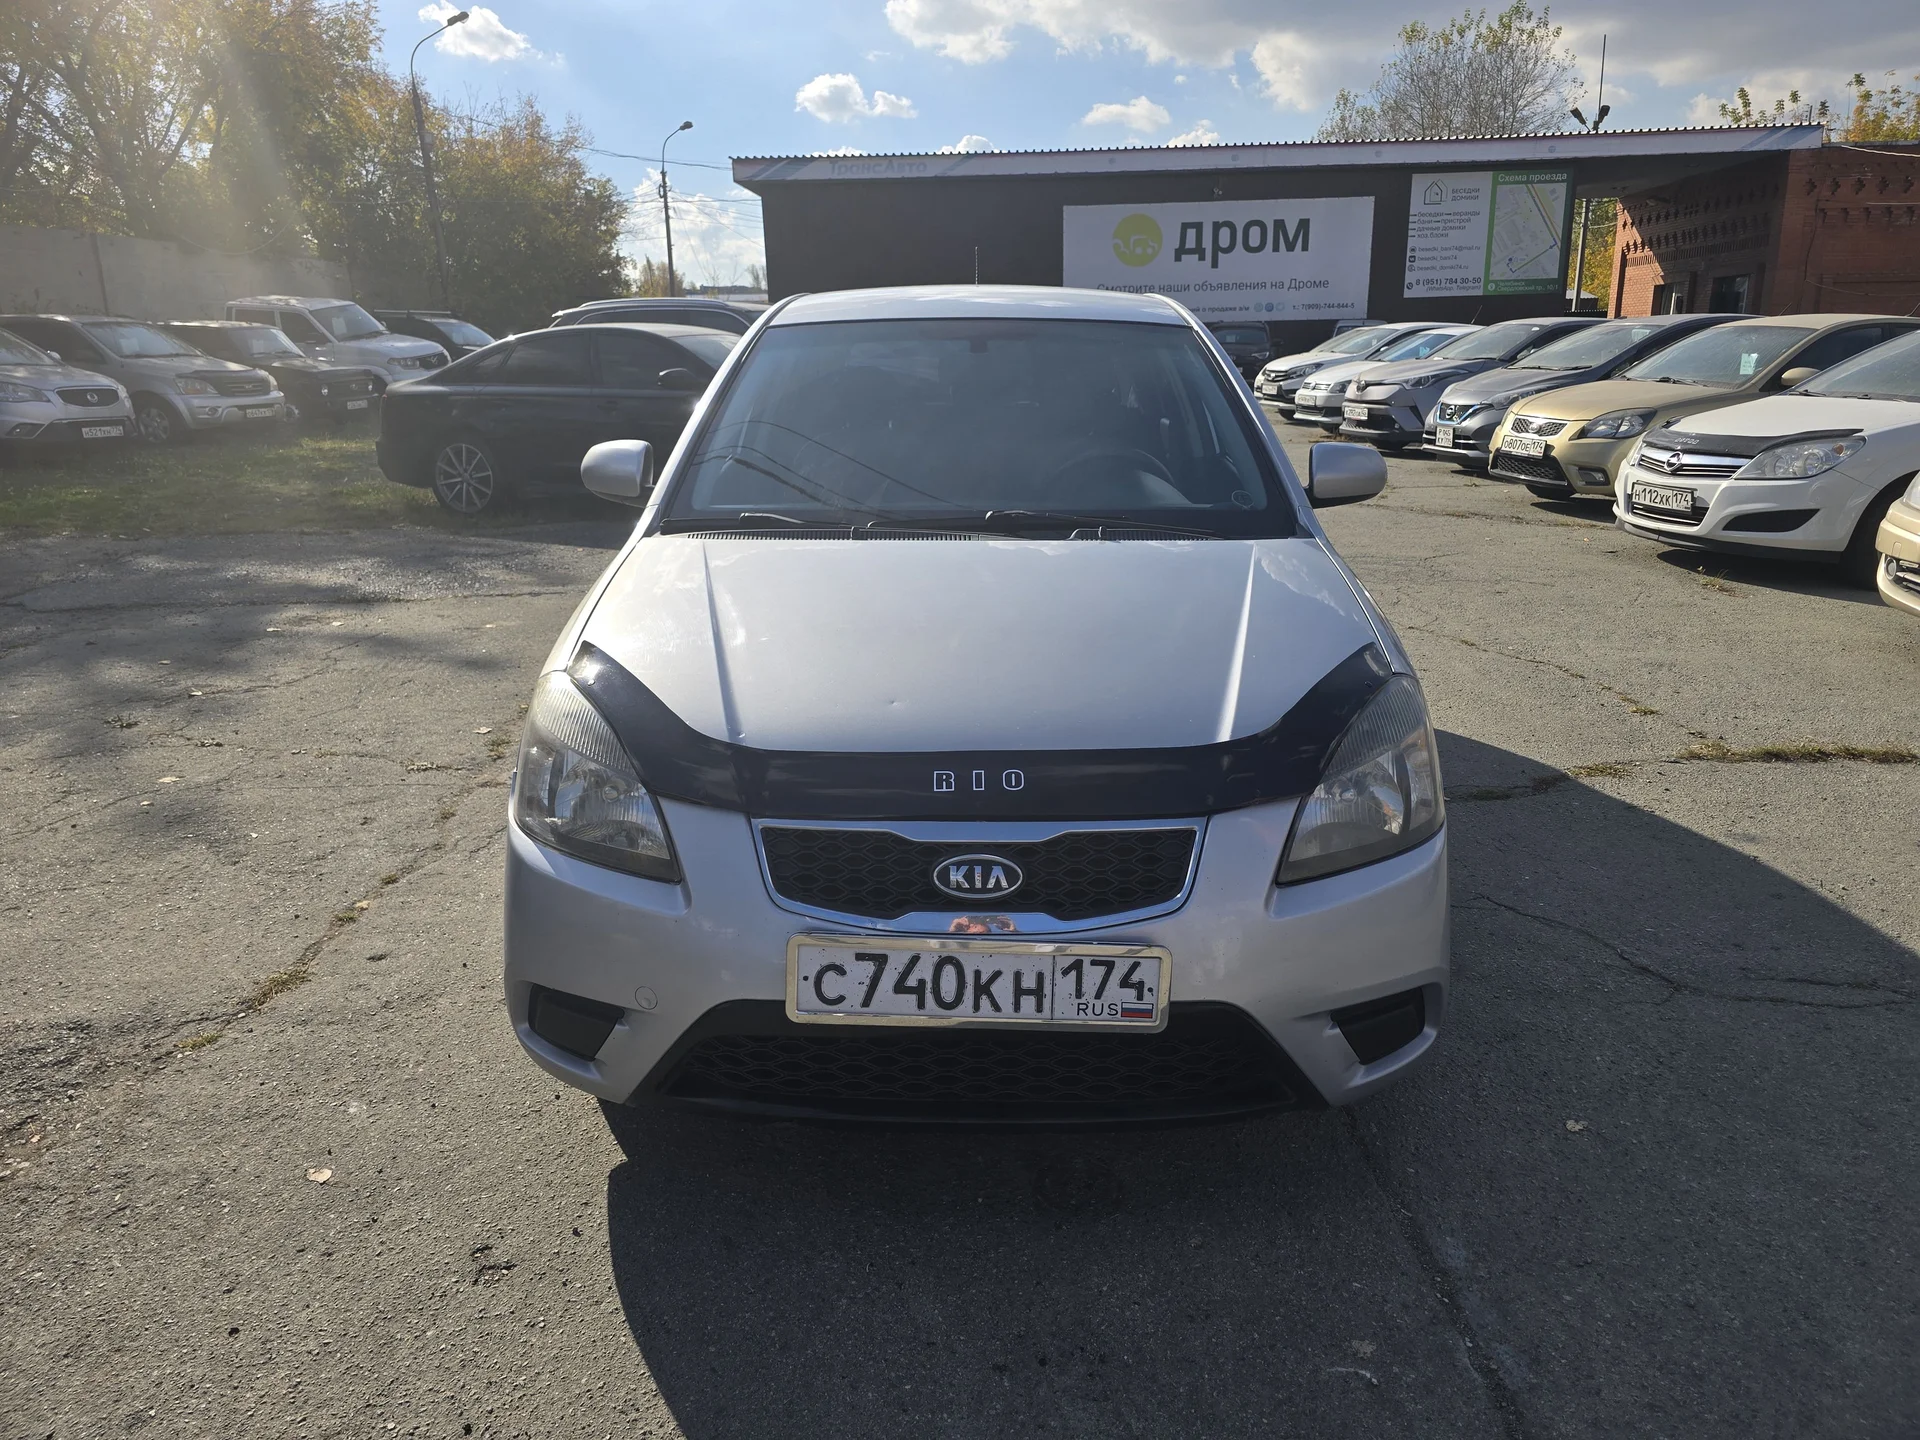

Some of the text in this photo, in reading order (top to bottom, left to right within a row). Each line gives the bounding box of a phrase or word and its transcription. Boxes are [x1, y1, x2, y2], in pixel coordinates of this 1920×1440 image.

[1498, 173, 1568, 183] Схема проезда
[1451, 187, 1480, 195] БЕСЕДКИ
[1174, 217, 1310, 269] дром
[1158, 282, 1190, 292] наши
[1193, 279, 1267, 292] объявления
[1270, 280, 1284, 289] на
[1287, 278, 1330, 290] Дроме
[1415, 277, 1482, 287] 8 (951) 784 30-50
[1634, 487, 1689, 506] Н112ХК 174
[933, 769, 1025, 792] RIO
[949, 865, 1009, 889] KIA
[814, 952, 1146, 1013] С740КН 174
[1076, 1002, 1118, 1017] RUS
